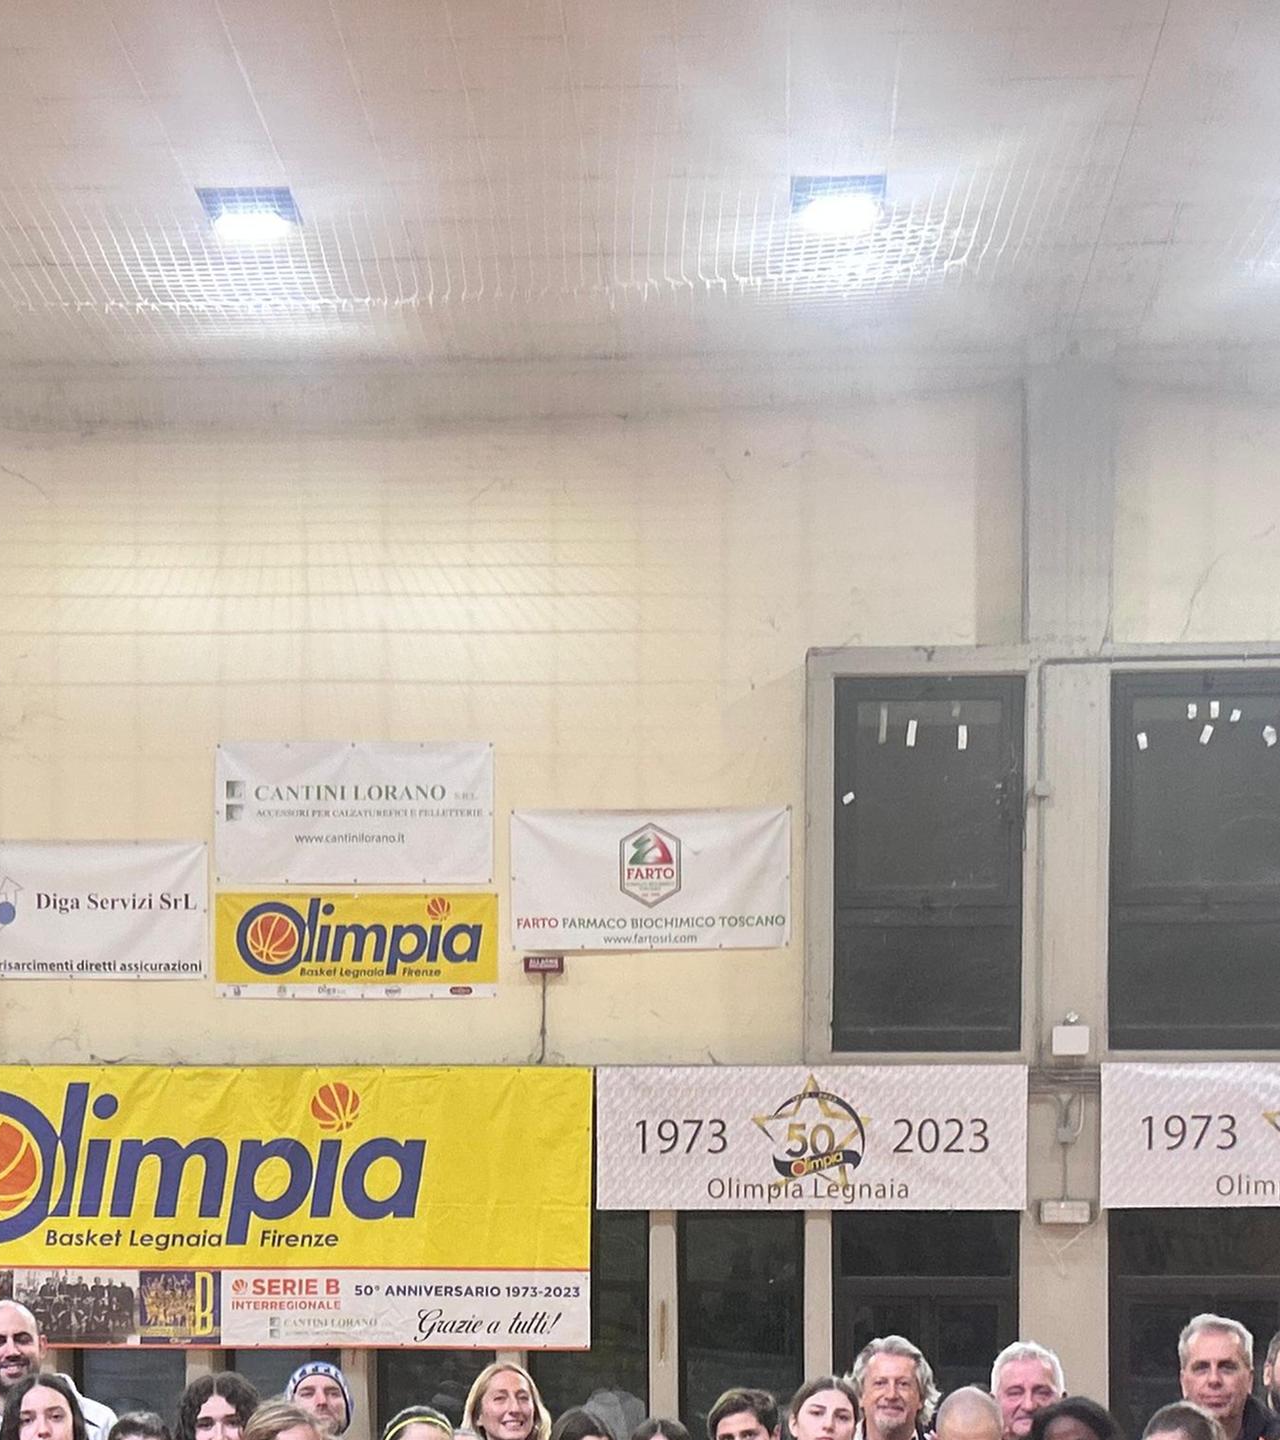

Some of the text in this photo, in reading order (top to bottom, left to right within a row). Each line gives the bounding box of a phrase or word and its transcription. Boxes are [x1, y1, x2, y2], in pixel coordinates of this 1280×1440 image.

[254, 784, 351, 802] CANTINI
[354, 784, 447, 801] LORANO
[294, 832, 406, 844] www.cantinilorano.it
[626, 867, 675, 880] FARTO
[36, 892, 198, 914] Diga Servizi SrL
[516, 915, 786, 929] FARTO FARMACO BIOCHIMICO TOSCANO
[236, 897, 483, 976] Olimpia
[603, 932, 698, 944] www.fartosrl.com
[77, 959, 117, 972] diretti
[119, 959, 203, 973] assicurazioni
[300, 967, 337, 977] Basket
[402, 967, 442, 977] Firenze
[634, 1118, 728, 1155] 1973
[785, 1122, 836, 1158] 50
[892, 1117, 990, 1154] 2023
[1140, 1114, 1238, 1150] 1973
[706, 1177, 910, 1204] Olimpia Legnaia
[45, 1227, 340, 1252] Basket Legnaia Firenze
[252, 1279, 341, 1296] SERIE B
[354, 1284, 581, 1299] 50° ANNIVERSARIO 1973-2023
[231, 1300, 341, 1311] INTERREGIONALE
[414, 1308, 563, 1342] Grazie a tutti!
